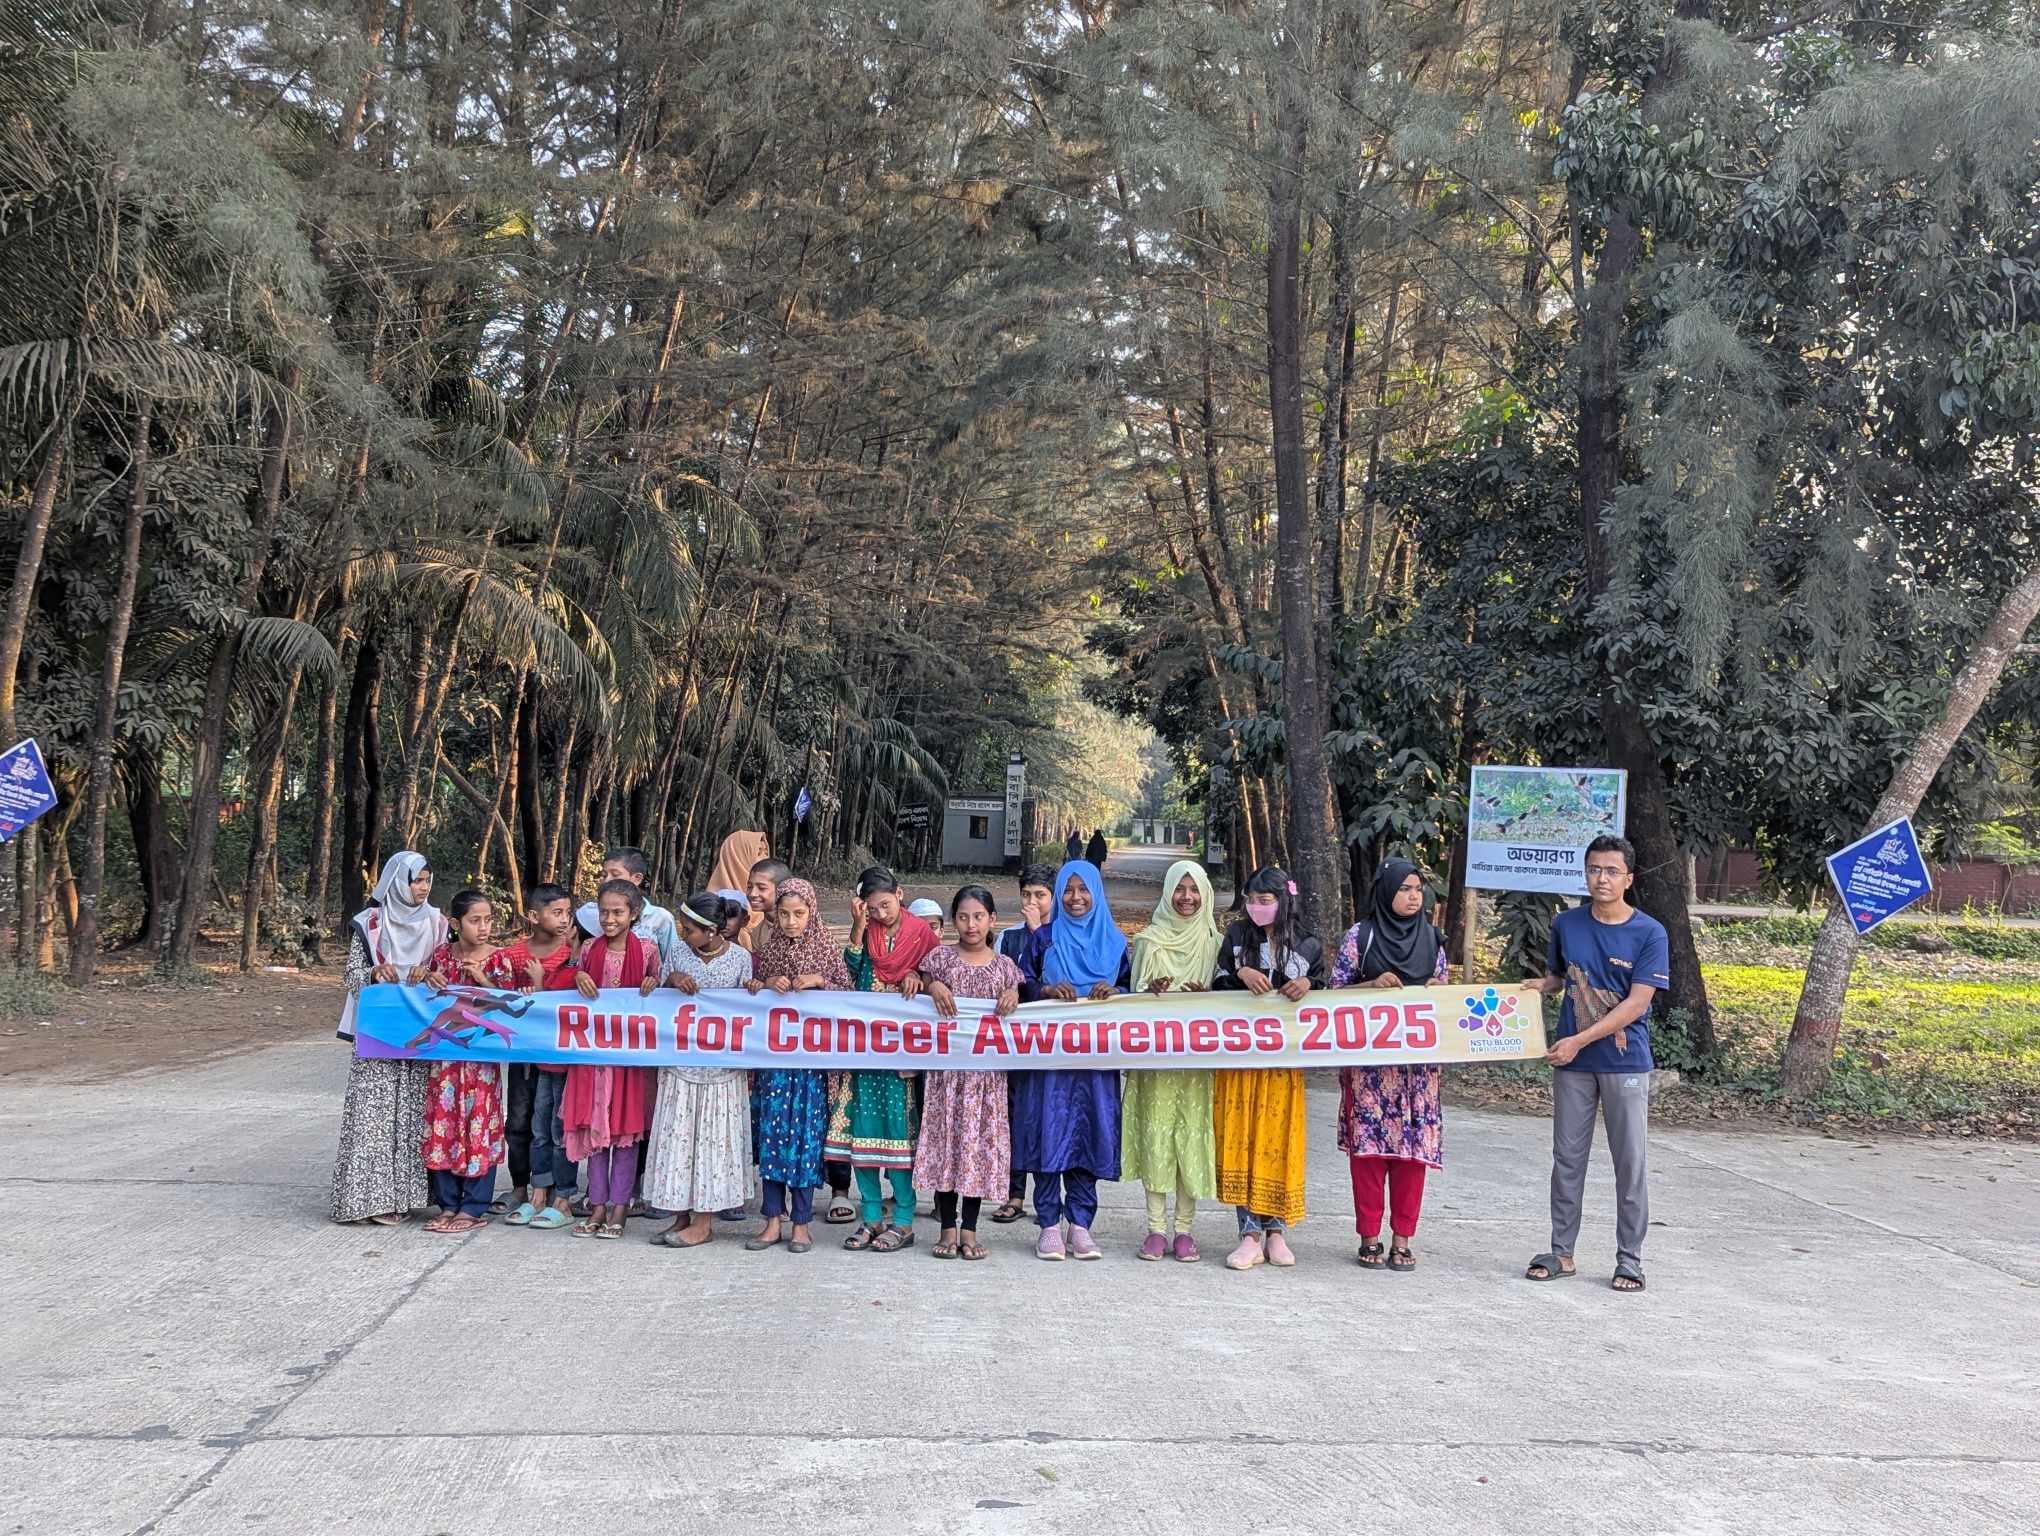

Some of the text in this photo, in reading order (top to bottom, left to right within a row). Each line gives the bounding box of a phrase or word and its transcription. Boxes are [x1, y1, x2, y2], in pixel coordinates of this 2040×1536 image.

[1507, 847, 1575, 864] অভয়ারণ্য
[1494, 864, 1513, 873] ভালো
[1539, 867, 1561, 876] আমরা
[1563, 869, 1583, 878] ভালো
[557, 1003, 1437, 1055] Run for Cancer Awareness 2025
[1494, 1038, 1522, 1046] BLOOD
